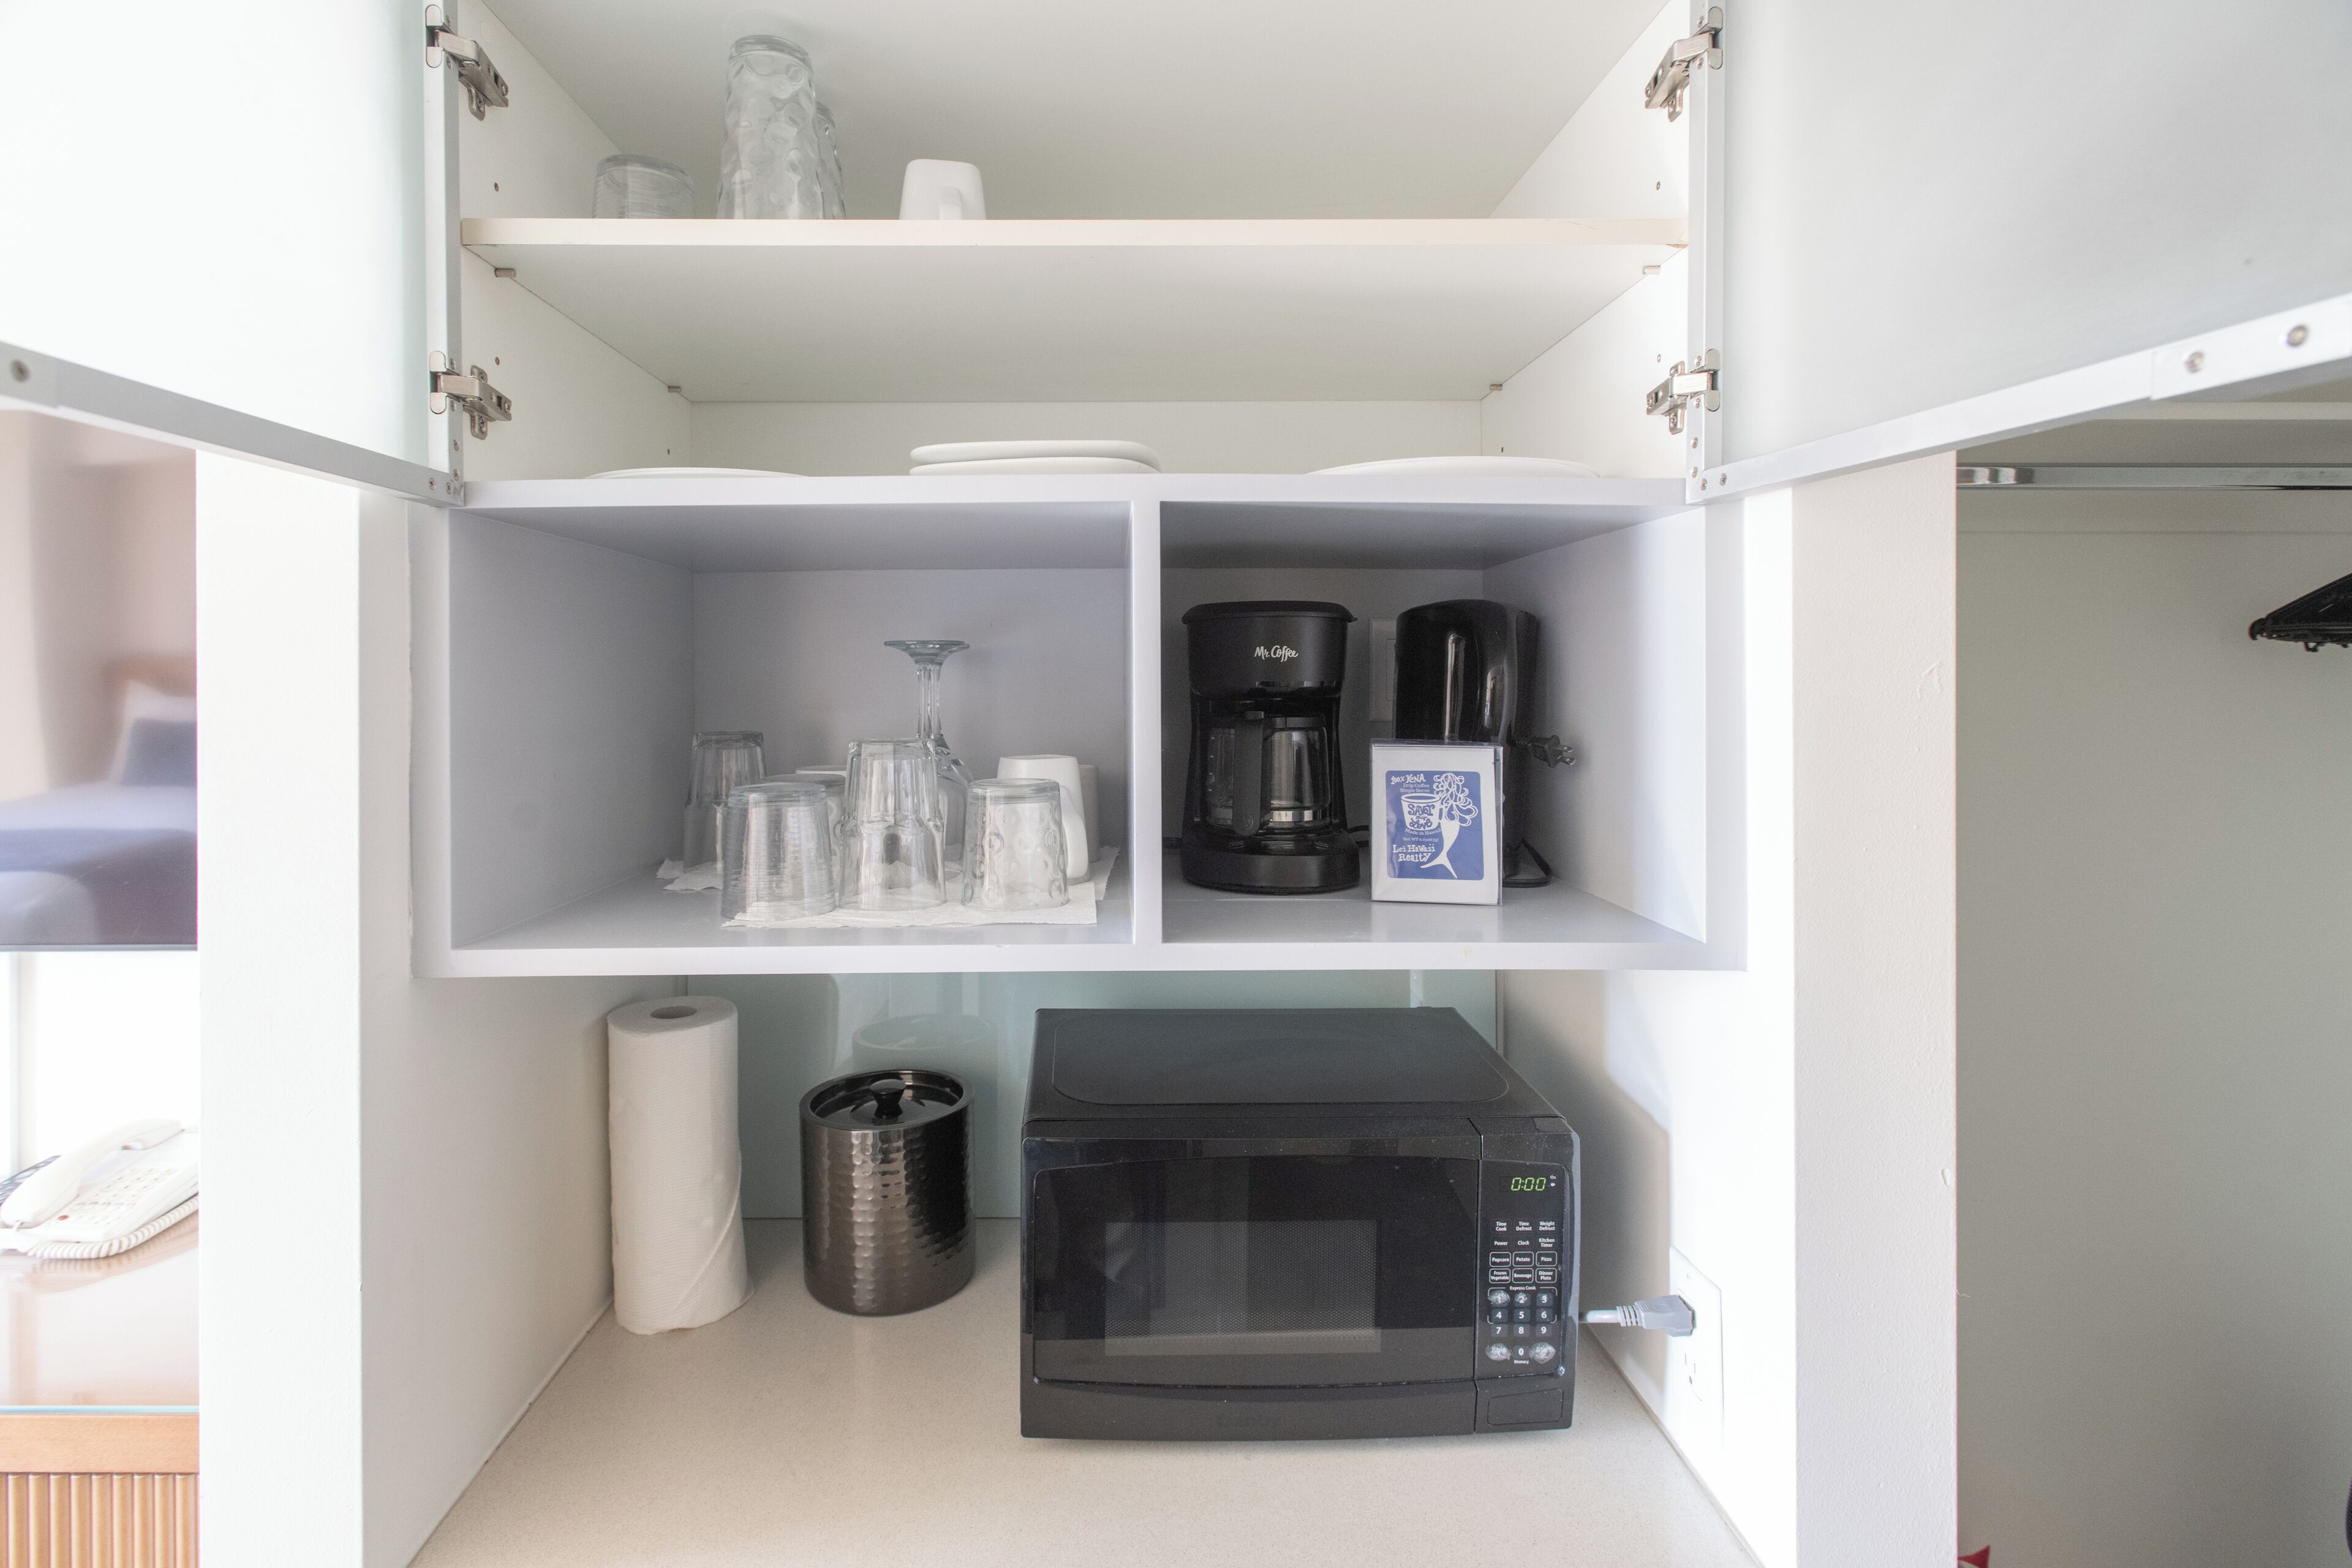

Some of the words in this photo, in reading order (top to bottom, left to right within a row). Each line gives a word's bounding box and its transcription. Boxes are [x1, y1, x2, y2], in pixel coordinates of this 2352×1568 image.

[1254, 646, 1270, 660] Mr.
[1271, 645, 1298, 662] Coffee
[1392, 844, 1406, 853] Lei
[1510, 1177, 1547, 1191] 0:00
[1497, 1294, 1502, 1303] 1
[1542, 1295, 1547, 1303] 3
